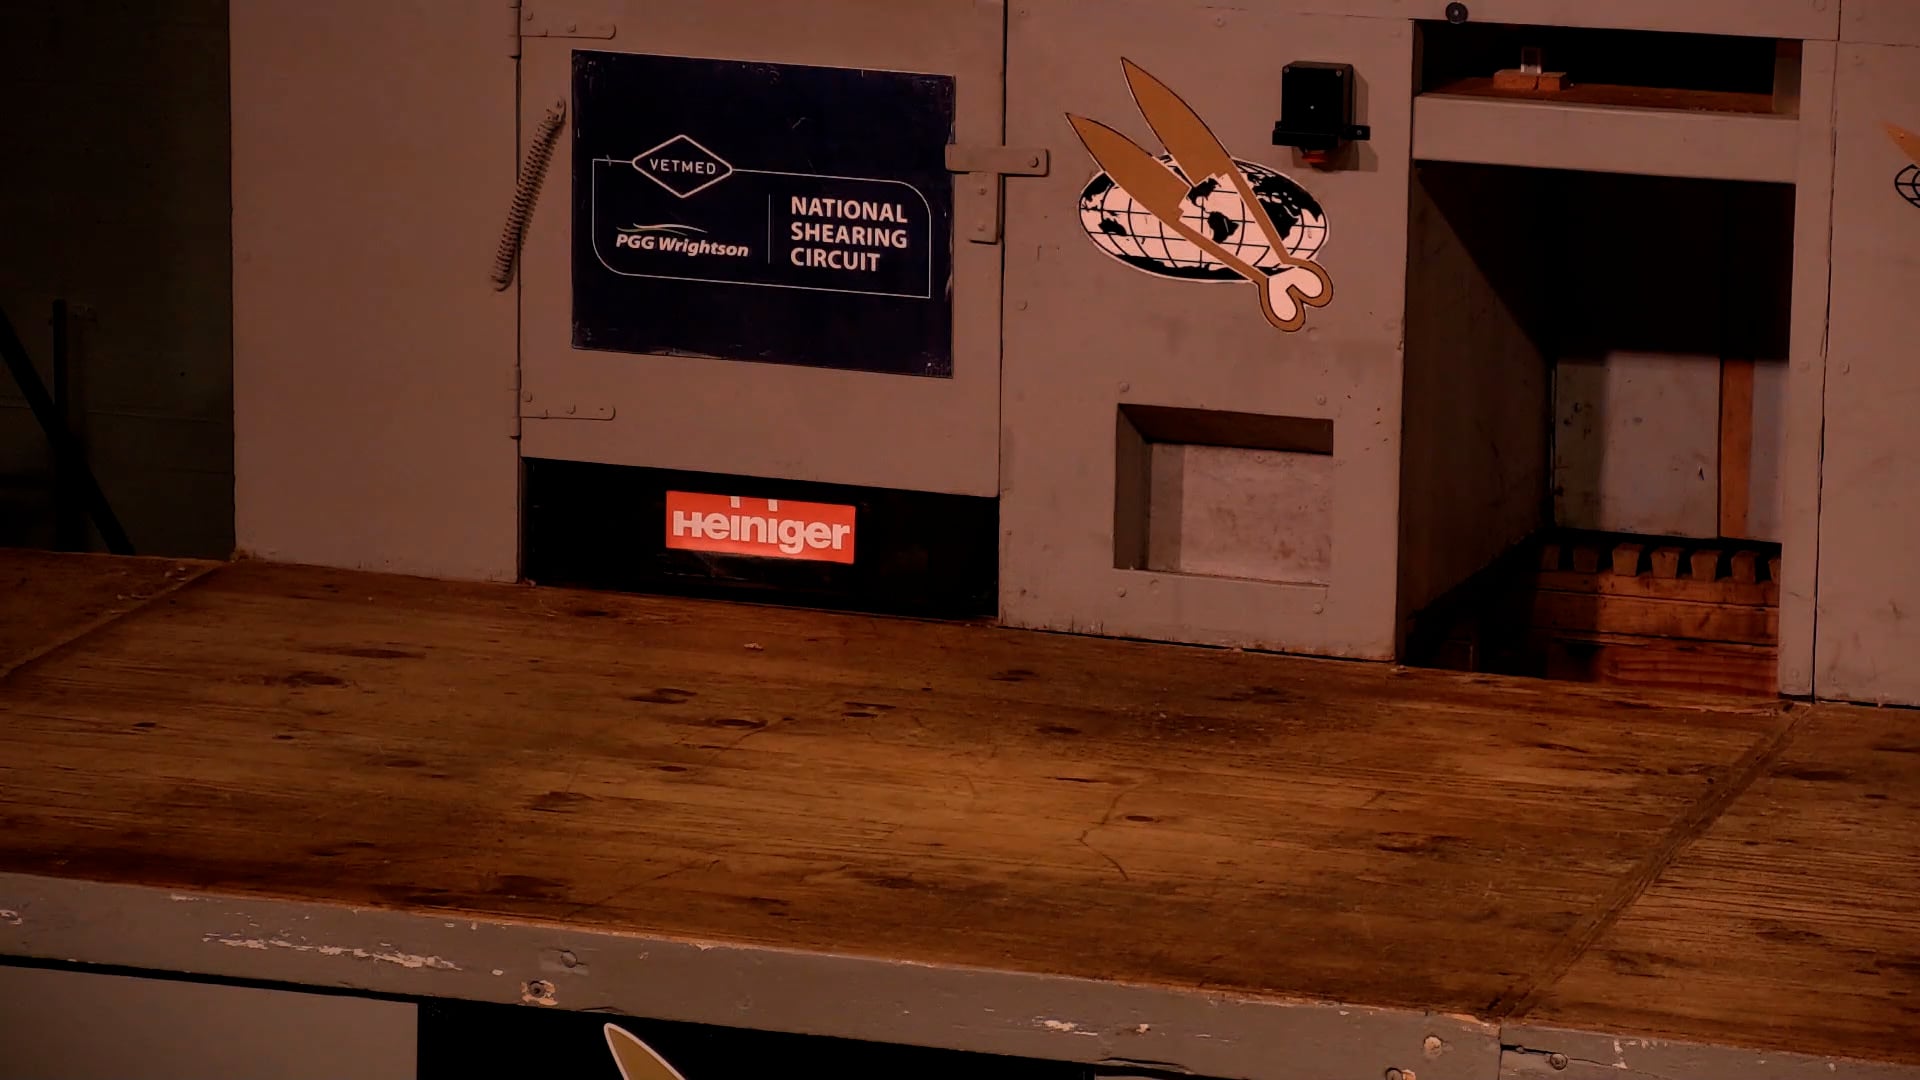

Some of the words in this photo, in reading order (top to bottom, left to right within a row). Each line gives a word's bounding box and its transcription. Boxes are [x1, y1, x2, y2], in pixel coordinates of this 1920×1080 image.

[650, 158, 717, 176] VETMED
[791, 196, 908, 223] NATIONAL
[616, 234, 654, 251] PGG
[658, 236, 749, 257] Wrightson
[790, 222, 907, 249] SHEARING
[790, 248, 881, 272] CIRCUIT
[673, 496, 850, 554] Heiniger
